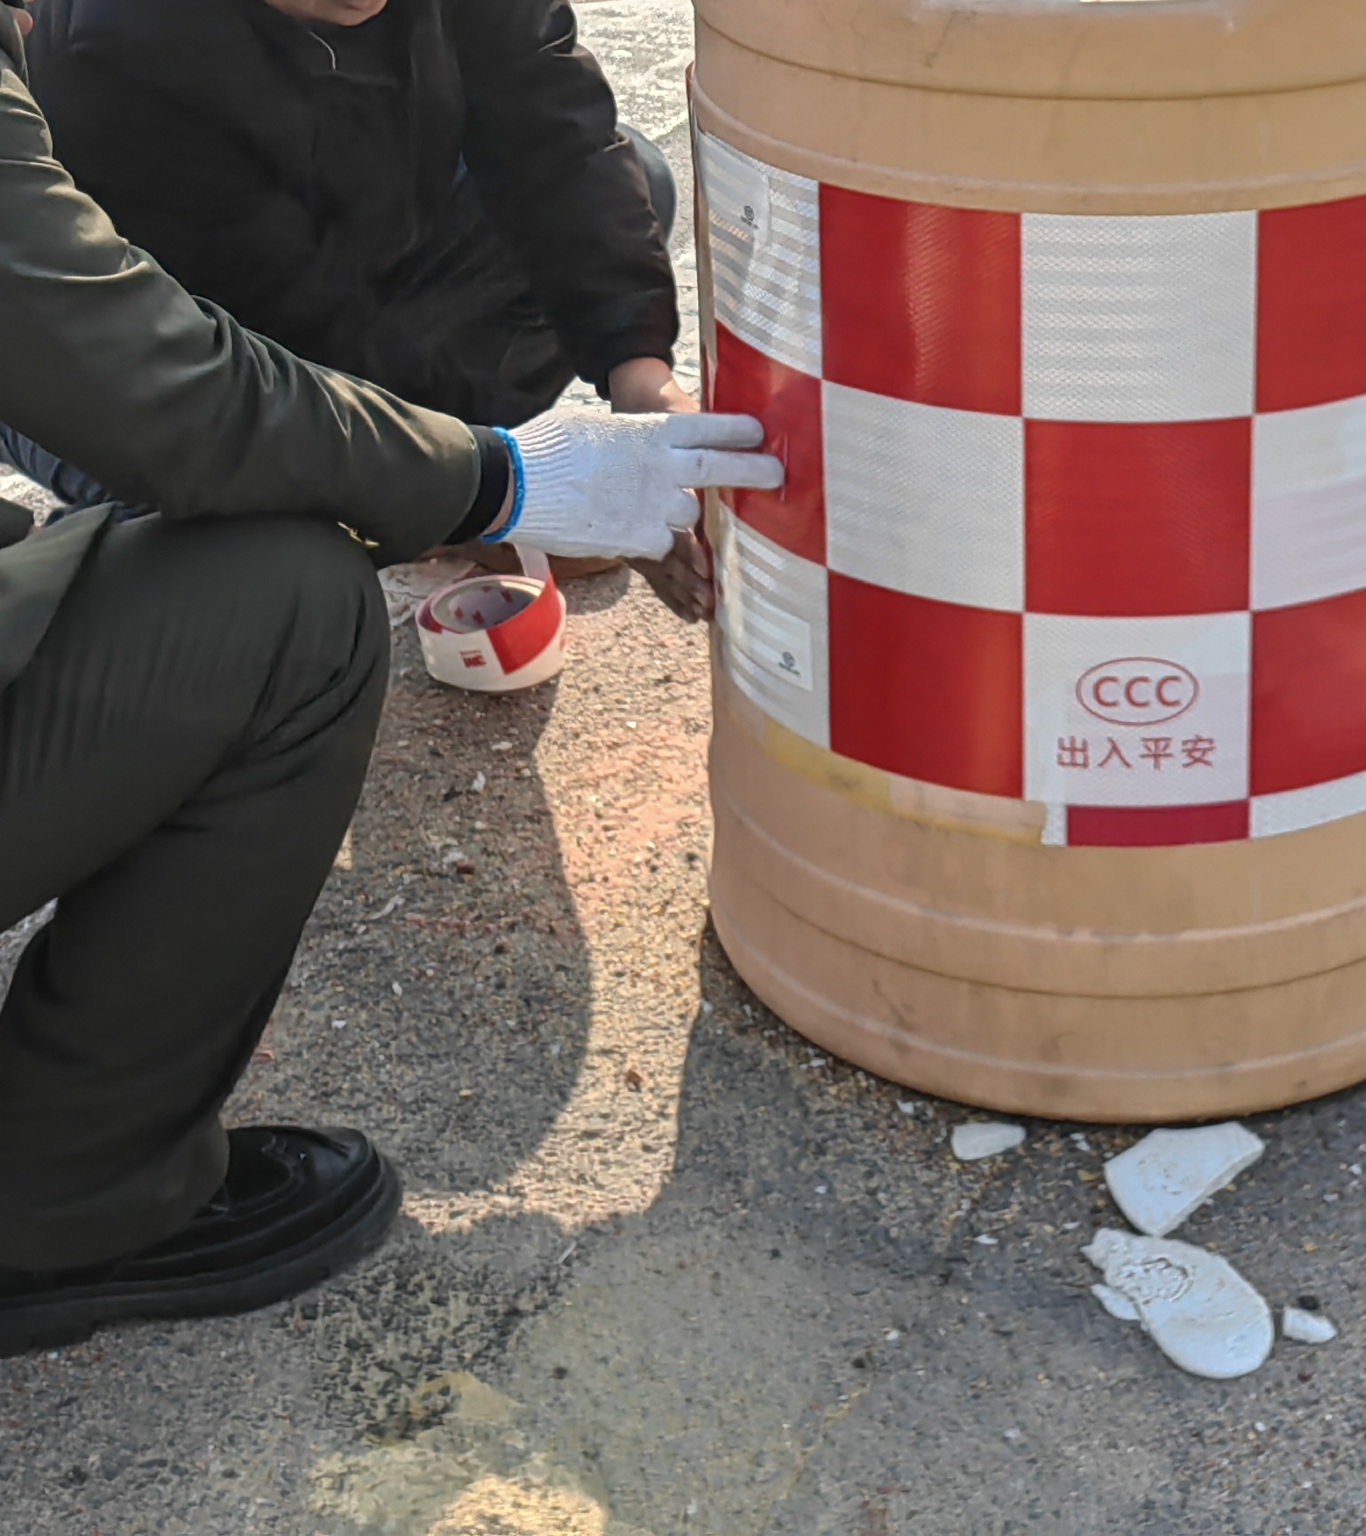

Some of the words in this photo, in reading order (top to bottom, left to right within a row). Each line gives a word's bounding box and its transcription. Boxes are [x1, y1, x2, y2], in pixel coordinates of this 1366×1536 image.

[1092, 674, 1184, 709] CCC
[1056, 733, 1218, 772] 出入平安
